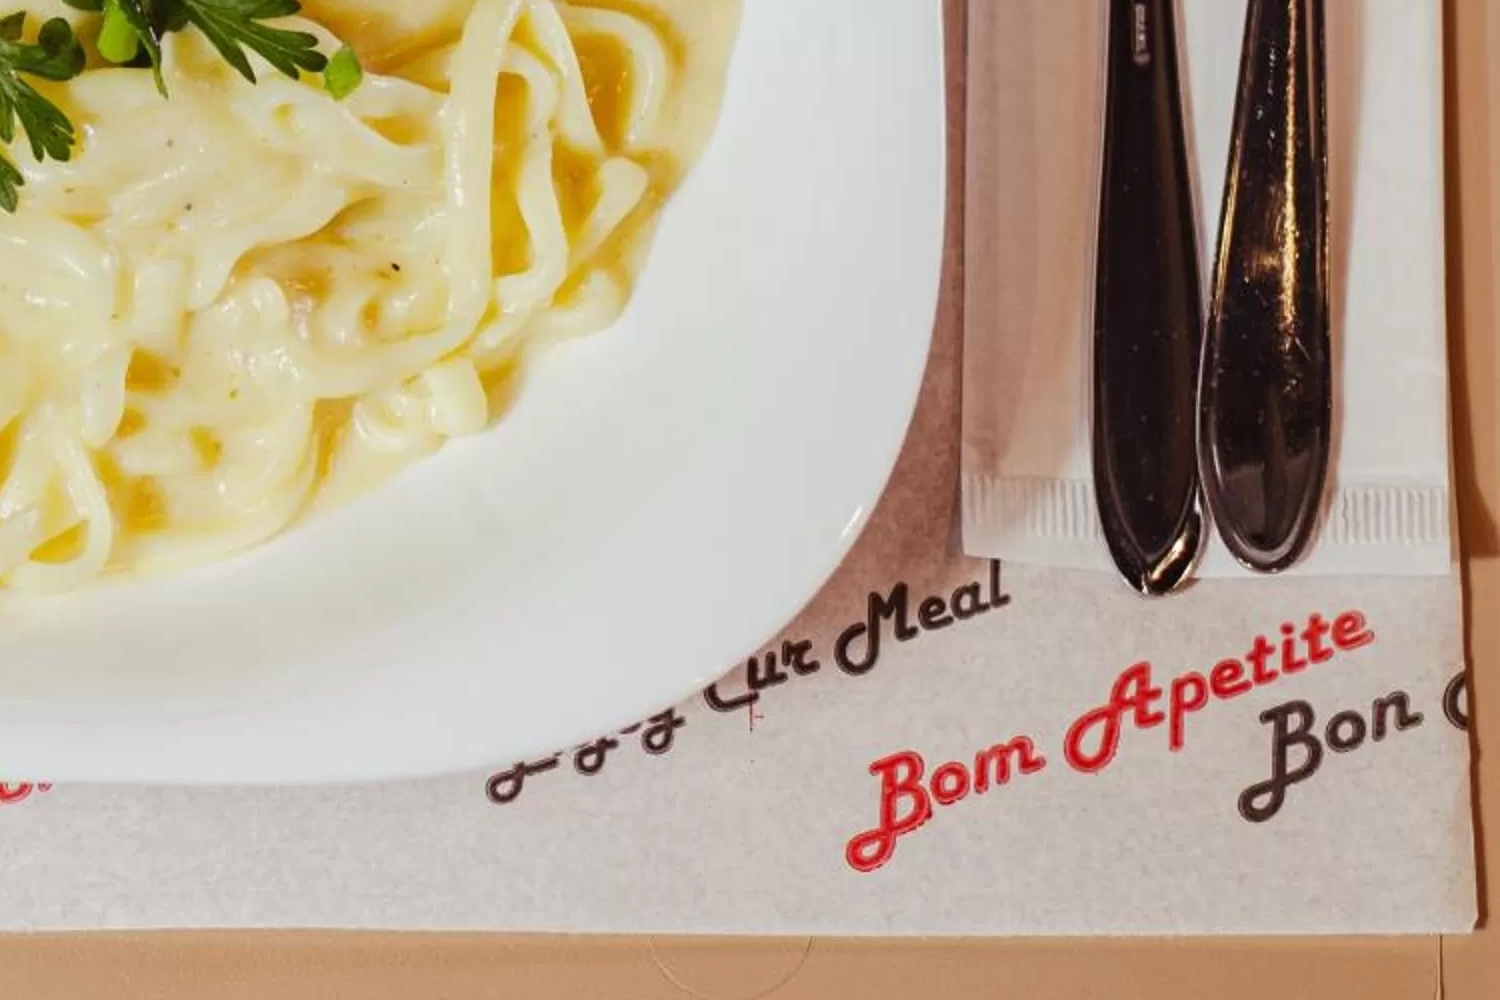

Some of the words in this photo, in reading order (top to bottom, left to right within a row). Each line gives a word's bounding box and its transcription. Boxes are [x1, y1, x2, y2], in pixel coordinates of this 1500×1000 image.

[834, 558, 1011, 677] Meal
[845, 734, 1046, 873] Bom
[1063, 608, 1375, 775] Apetite
[1237, 689, 1422, 824] Bon
